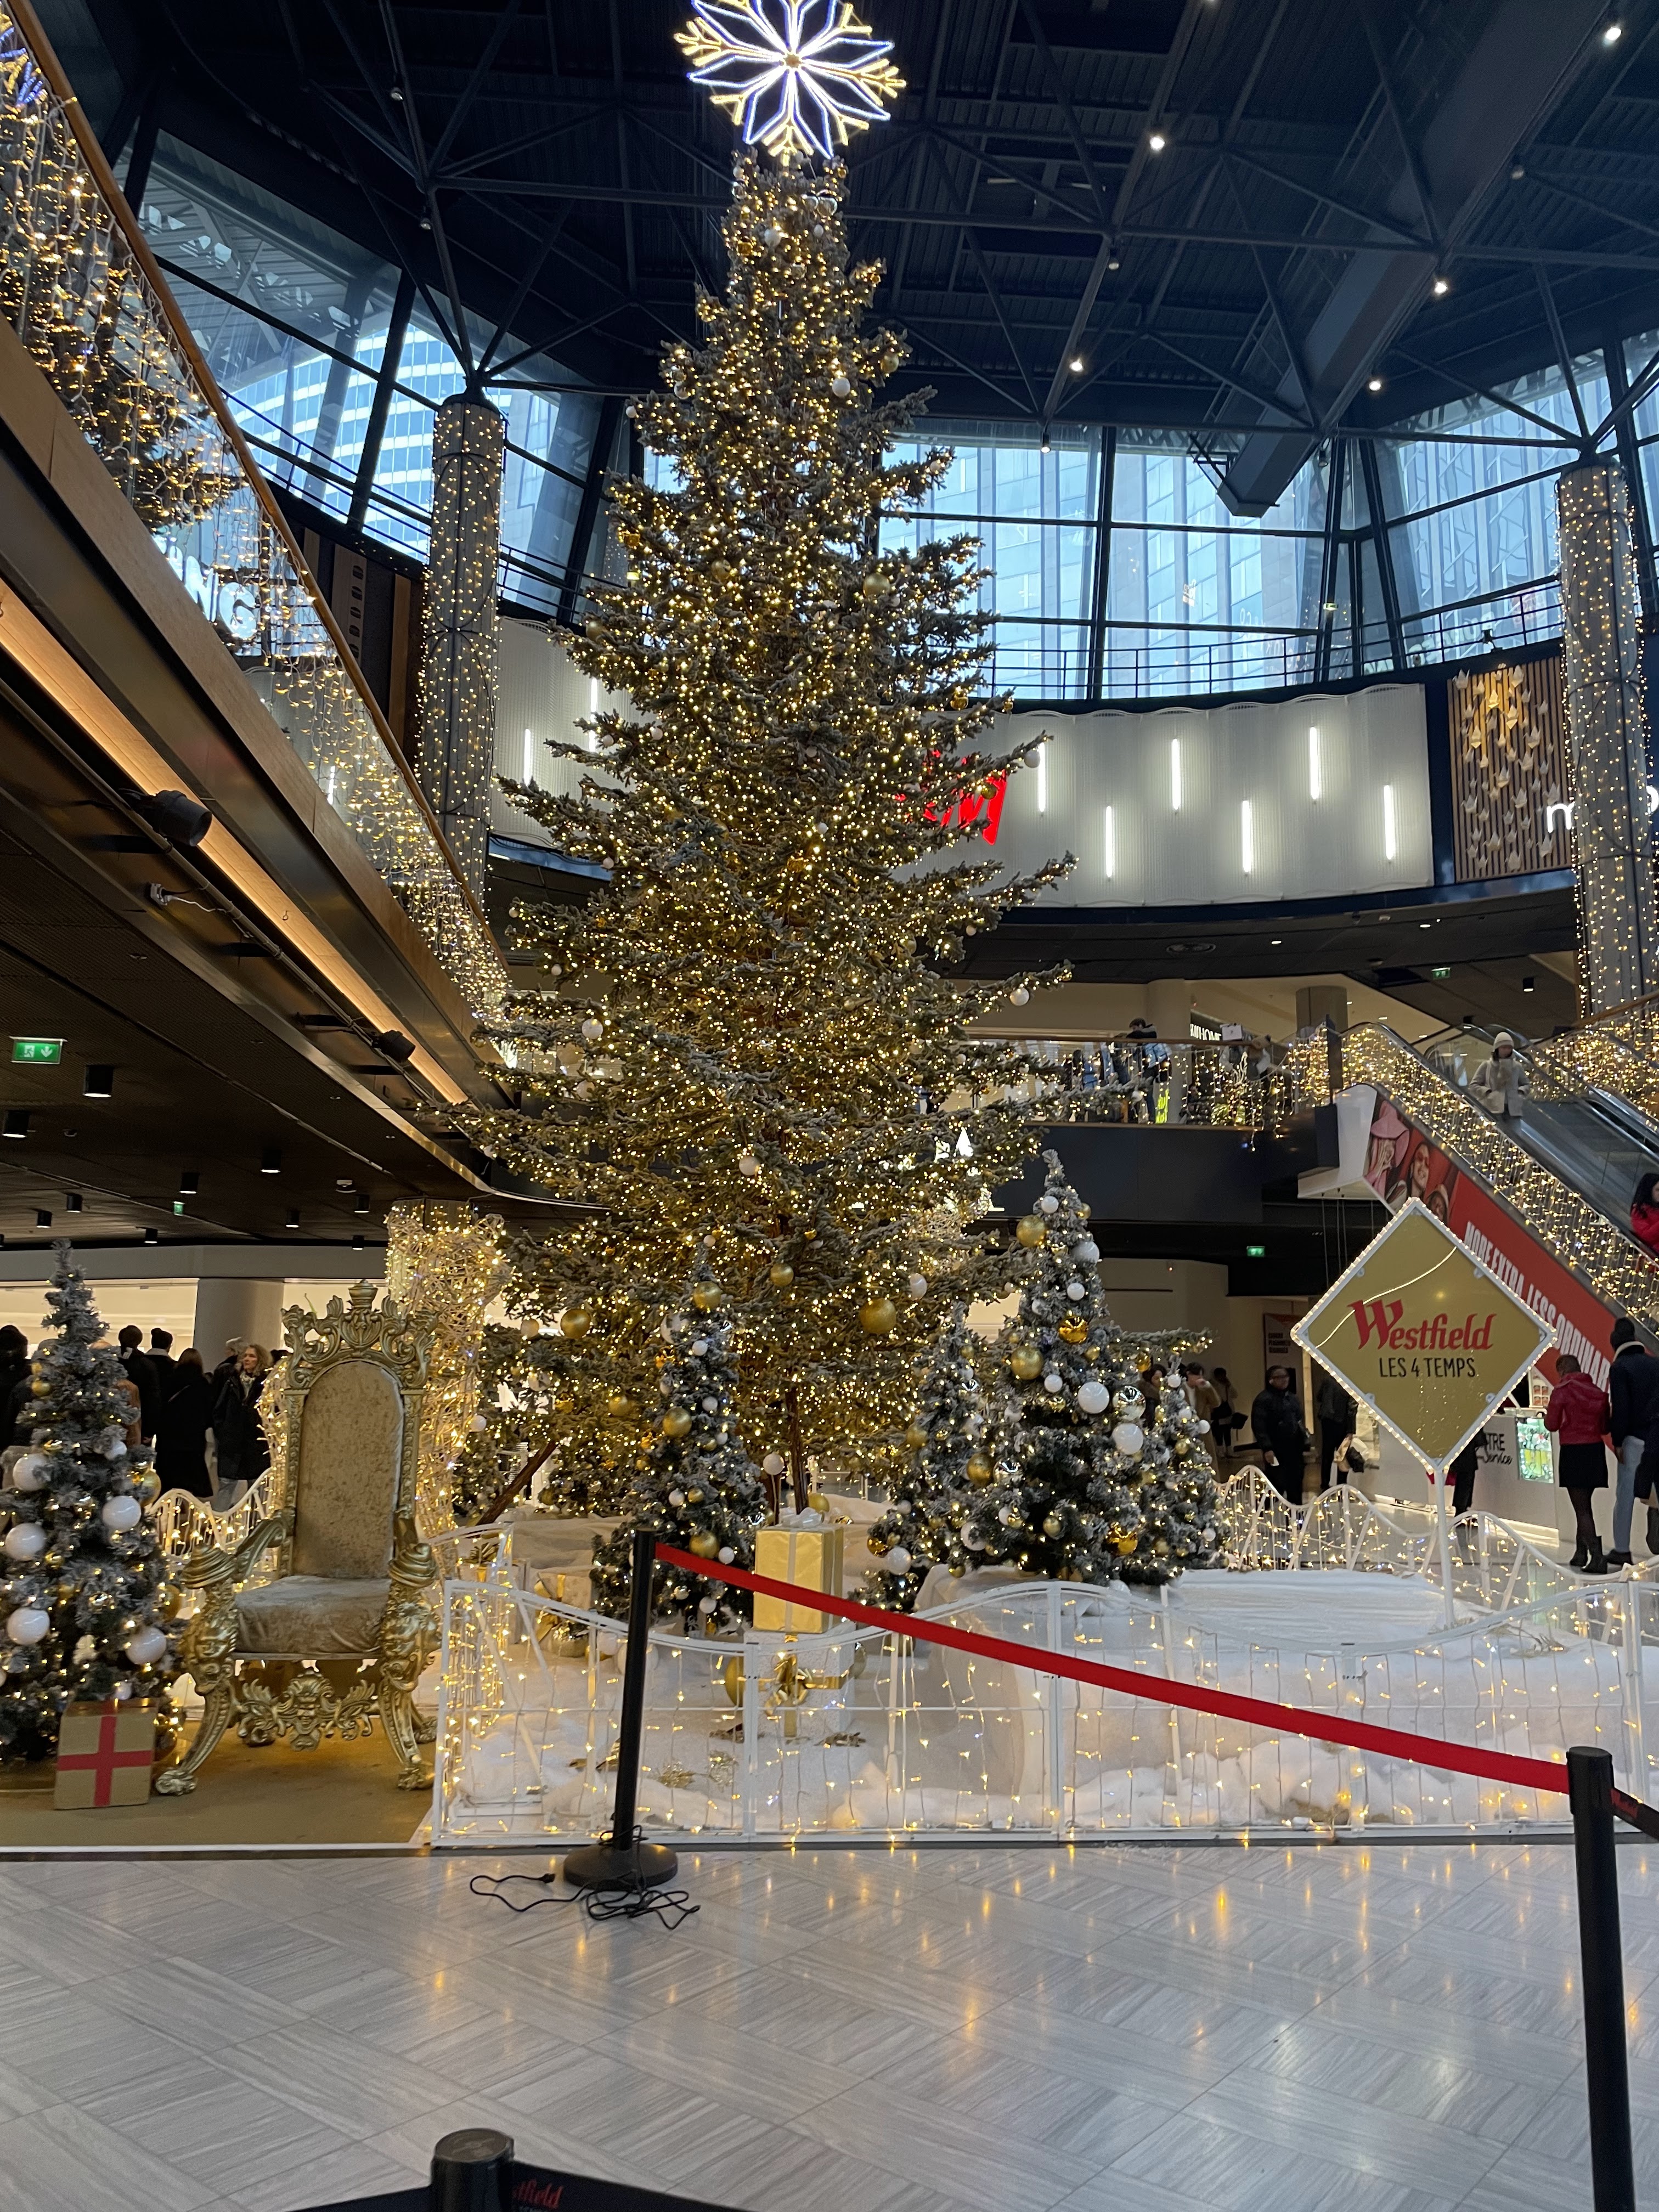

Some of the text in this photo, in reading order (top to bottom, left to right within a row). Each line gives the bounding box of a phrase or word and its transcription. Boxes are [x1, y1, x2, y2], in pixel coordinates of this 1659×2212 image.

[1346, 1299, 1497, 1350] Westfield
[1464, 1221, 1493, 1264] MORE
[1527, 1283, 1556, 1327] LESS
[1554, 1313, 1612, 1398] ORDINAR
[1379, 1357, 1476, 1378] LES 4 TEMPS
